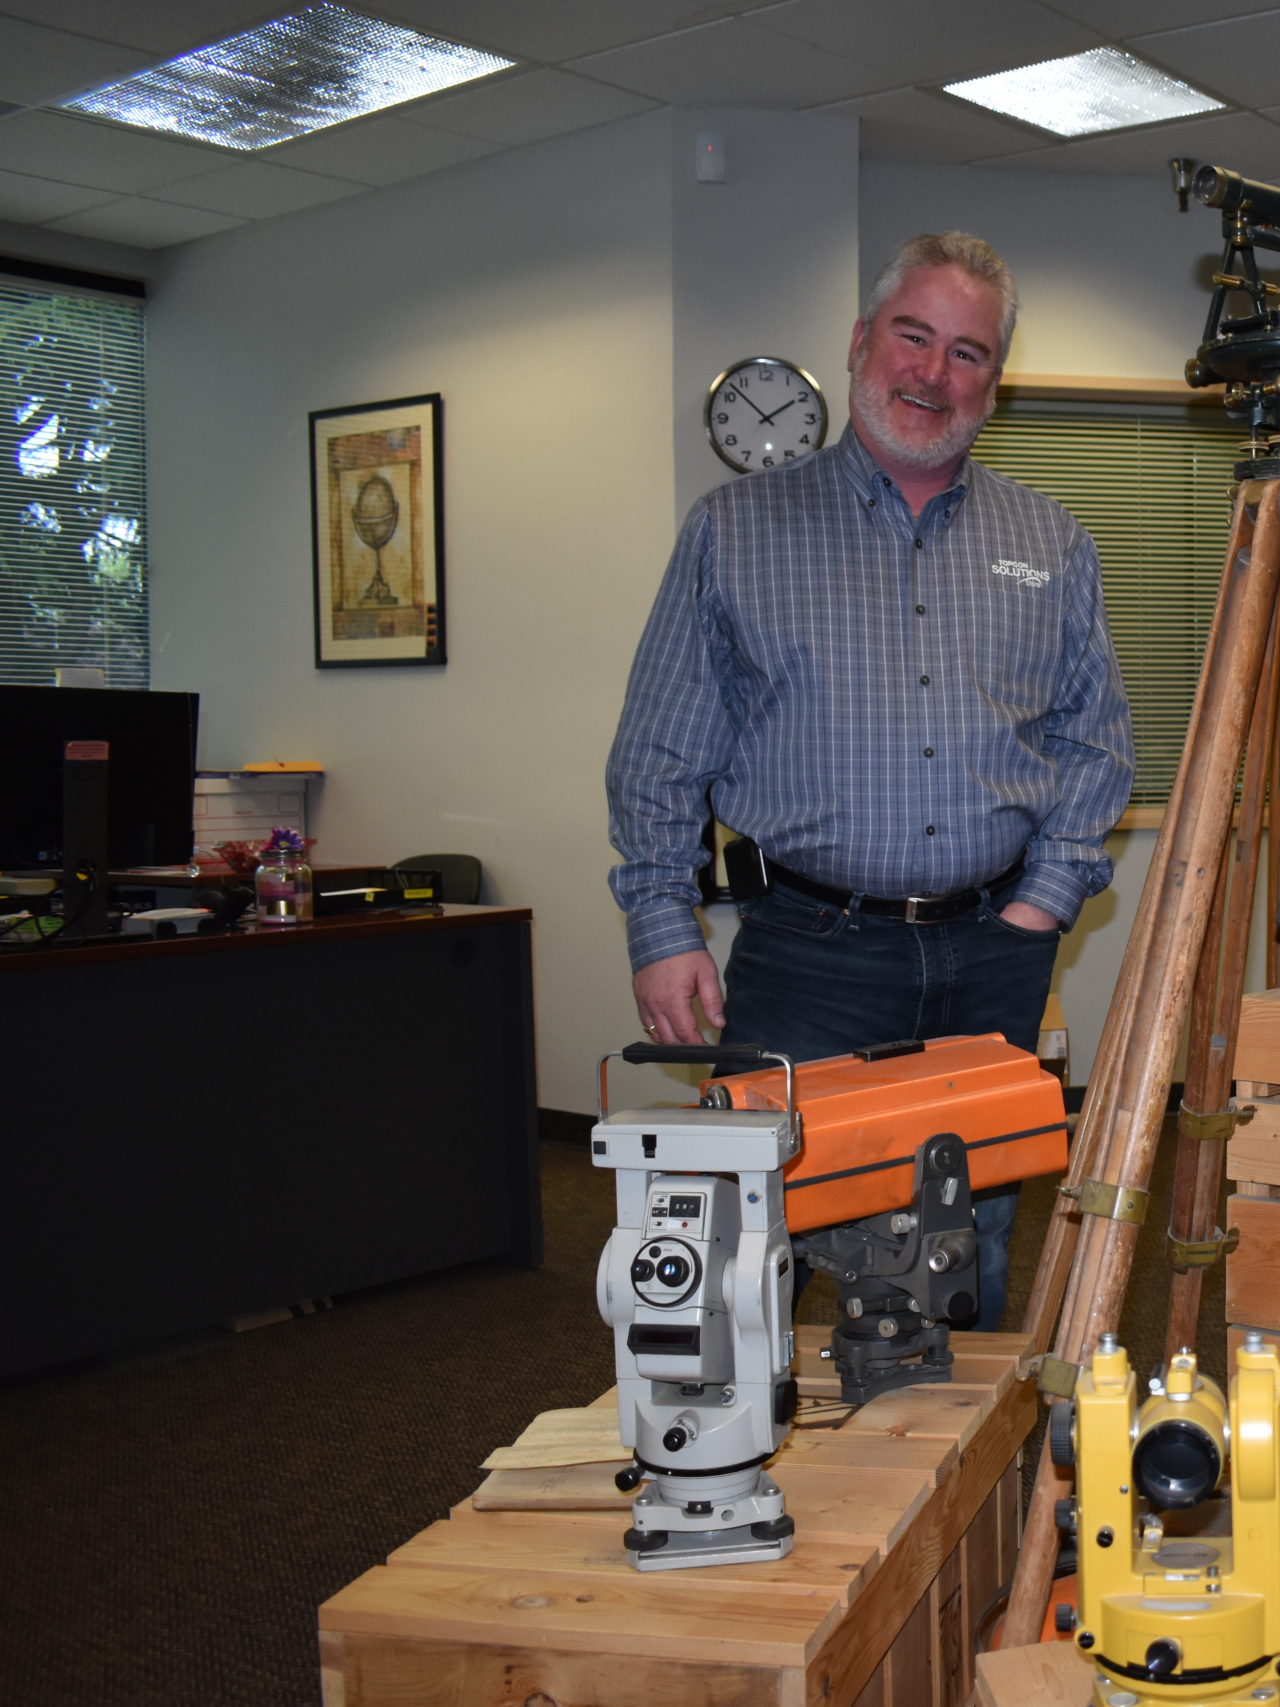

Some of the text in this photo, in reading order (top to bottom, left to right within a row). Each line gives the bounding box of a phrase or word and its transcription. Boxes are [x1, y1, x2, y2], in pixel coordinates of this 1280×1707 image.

[759, 369, 774, 381] 12
[740, 377, 748, 388] 11
[724, 391, 736, 403] 10
[798, 391, 809, 403] 2
[717, 412, 729, 425] 9
[804, 412, 817, 425] 3
[725, 434, 738, 446] 8
[799, 434, 810, 445] 4
[741, 450, 752, 462] 7
[784, 450, 796, 461] 5
[762, 456, 774, 468] 6
[998, 560, 1029, 569] TOPCON
[991, 564, 1050, 582] SOLUTIONS
